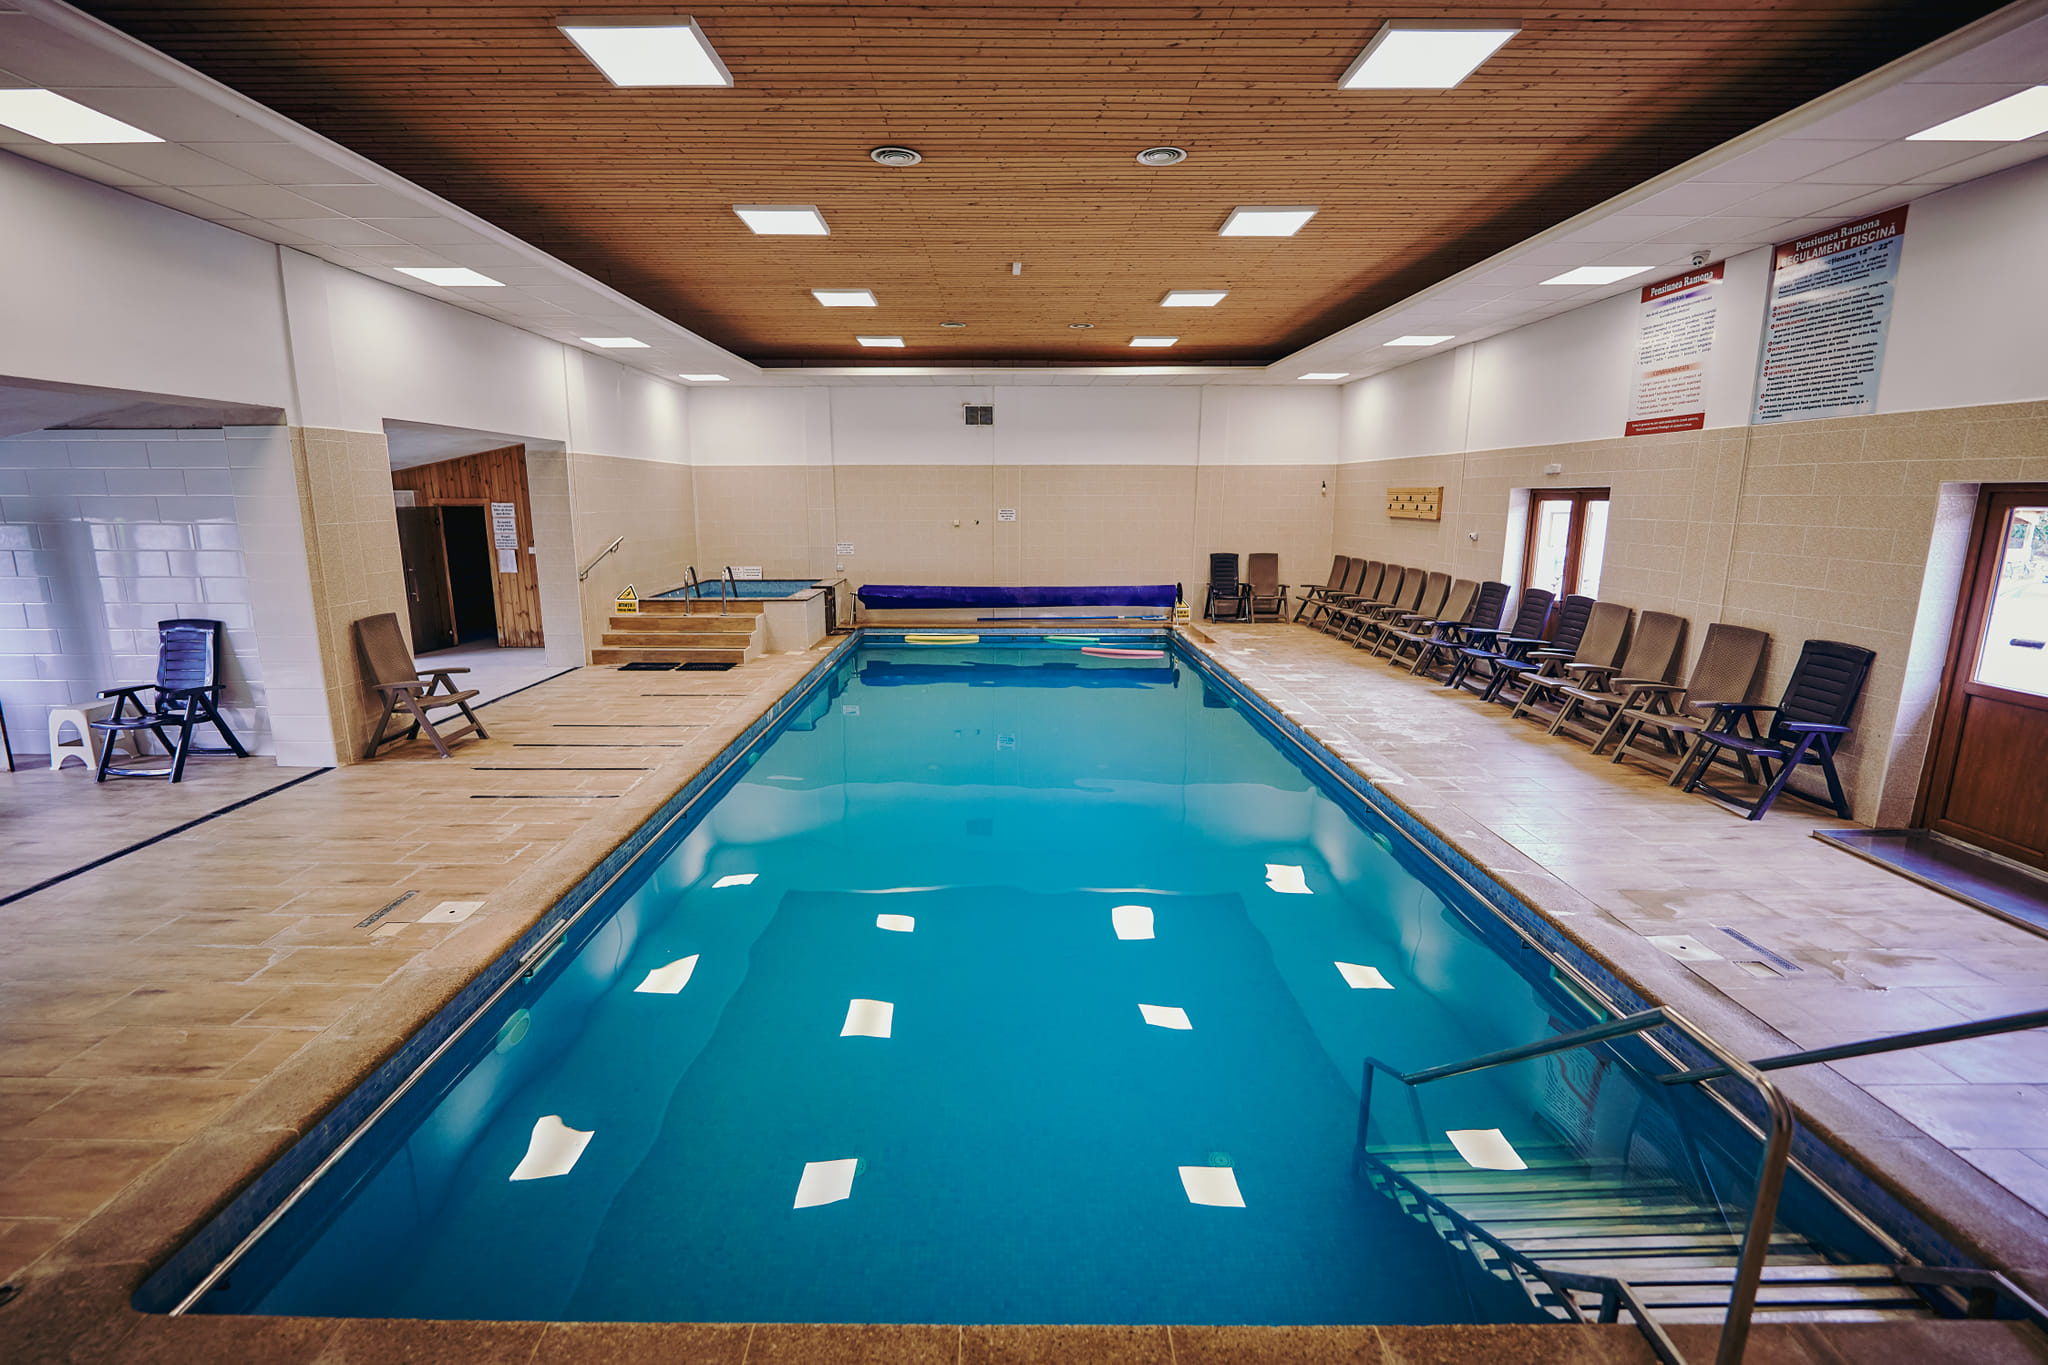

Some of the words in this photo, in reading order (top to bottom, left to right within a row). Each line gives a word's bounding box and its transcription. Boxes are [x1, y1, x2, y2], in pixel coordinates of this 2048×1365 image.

[1780, 239, 1848, 267] REGULAMENT
[1850, 222, 1897, 247] PISCINĂ
[1795, 231, 1839, 252] Pensiunea
[1840, 219, 1880, 238] Ramona
[1650, 280, 1683, 297] Pensiunea
[1683, 271, 1714, 287] Ramona
